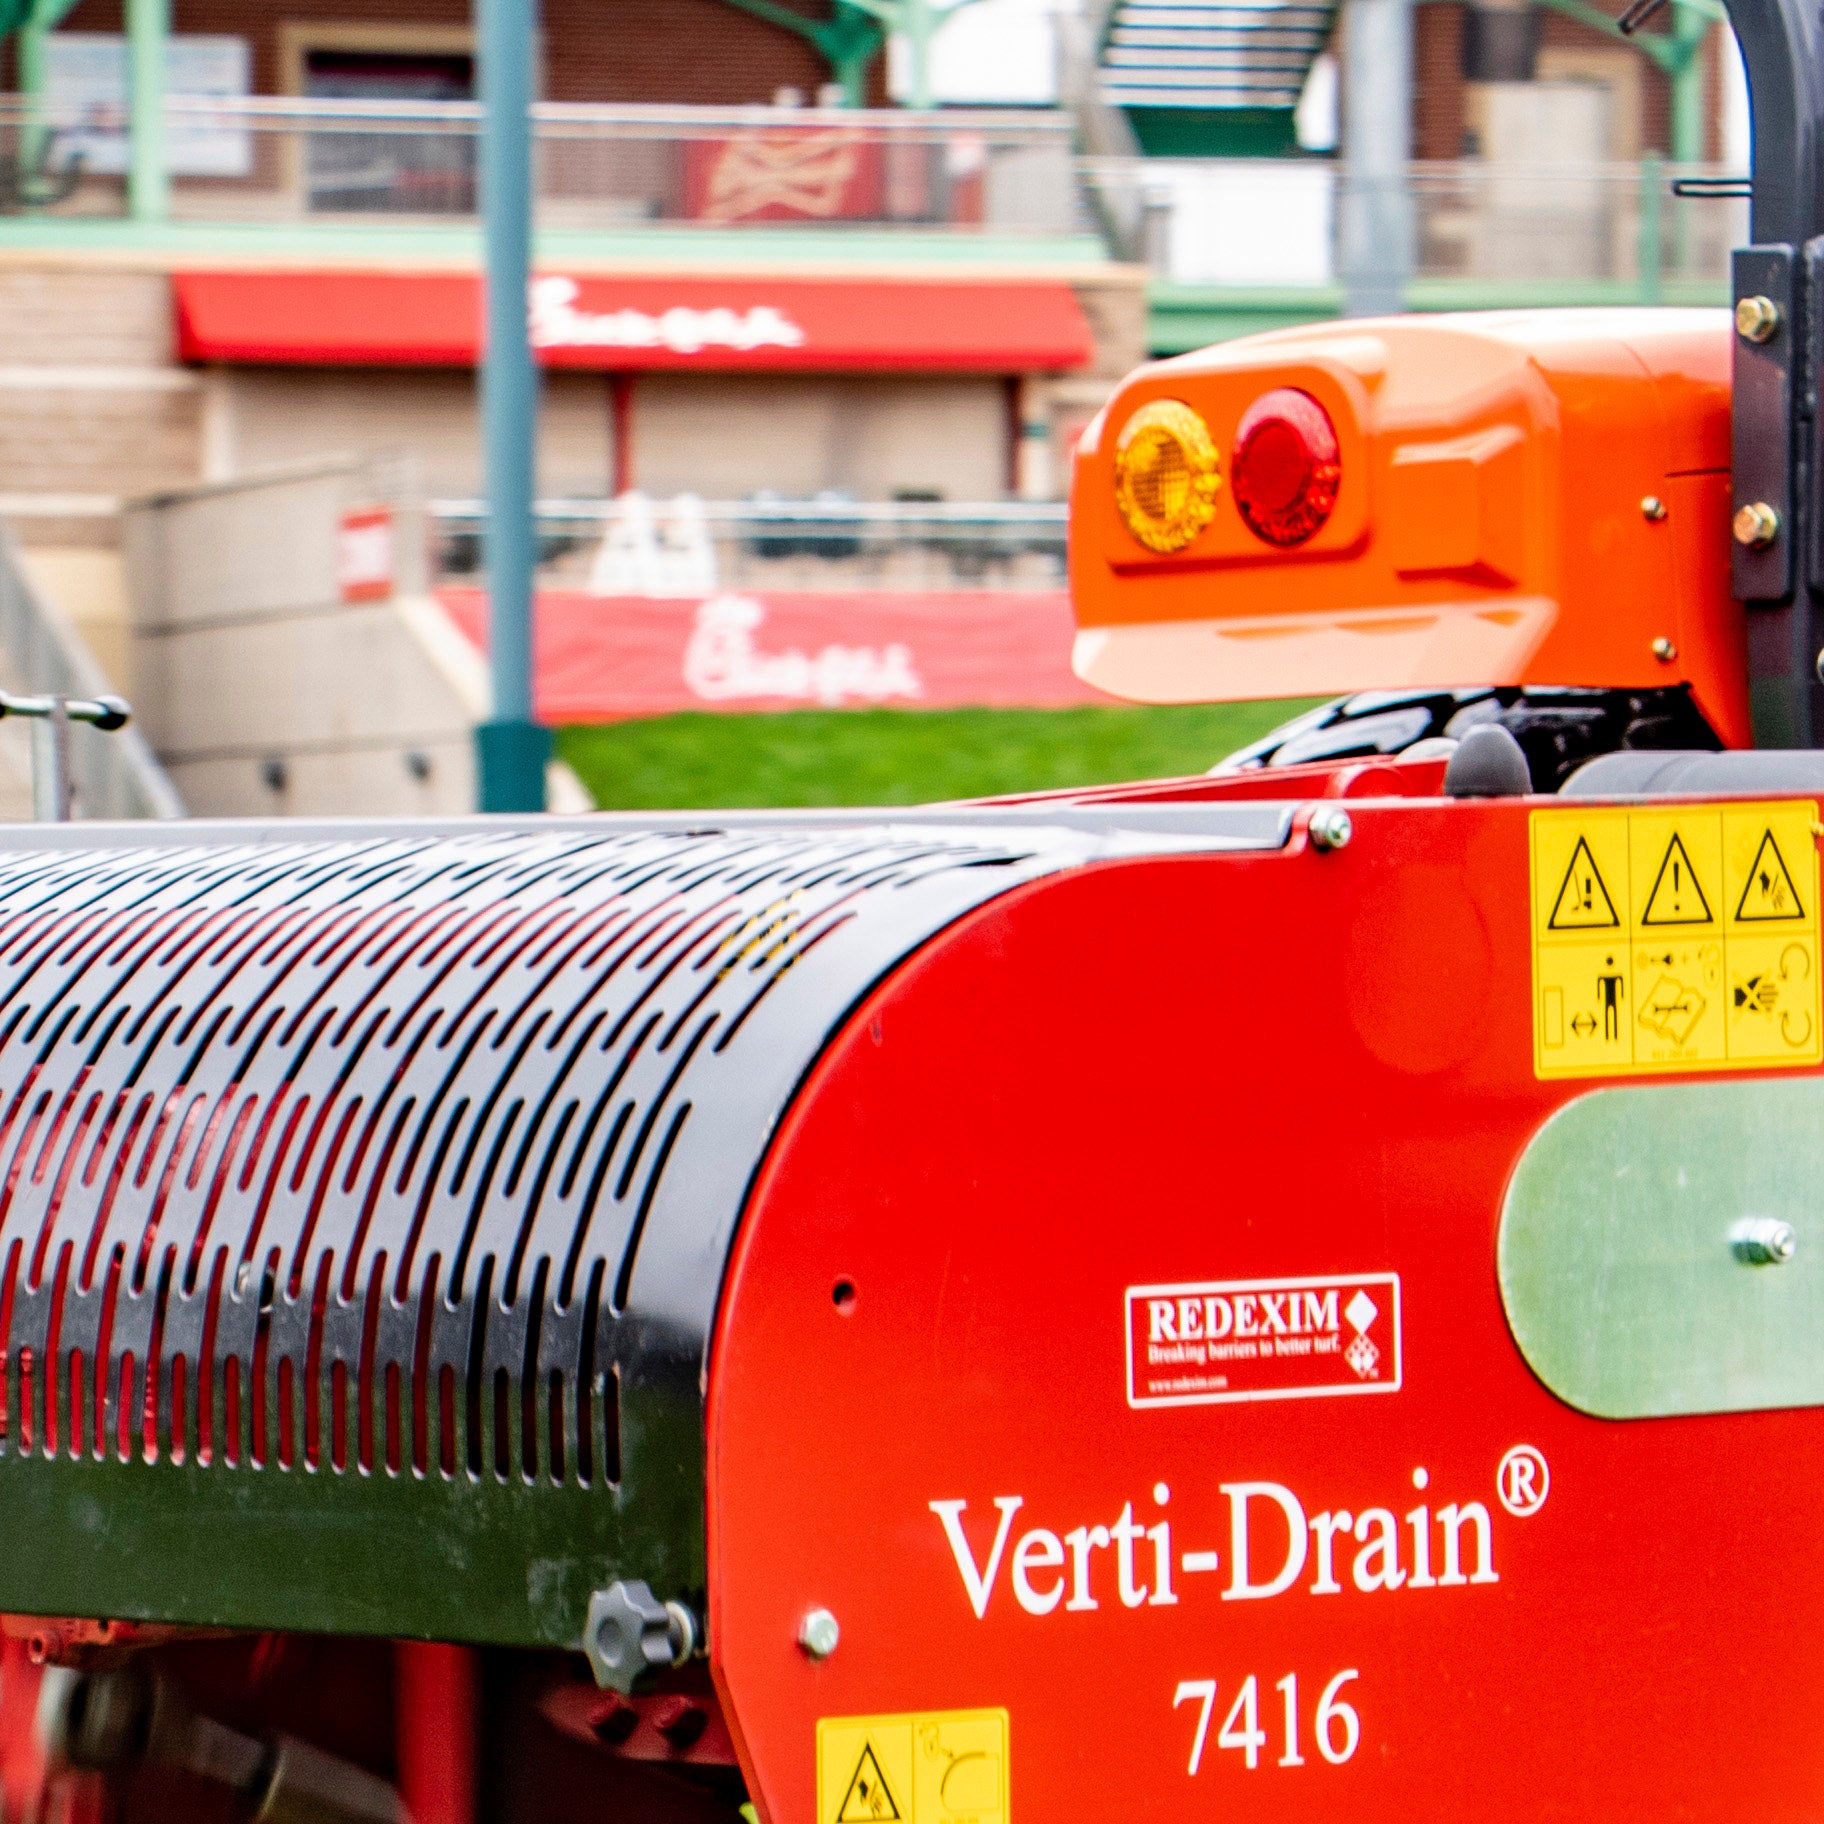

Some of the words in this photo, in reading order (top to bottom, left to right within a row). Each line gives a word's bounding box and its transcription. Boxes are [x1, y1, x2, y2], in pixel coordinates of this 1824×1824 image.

[1147, 1290, 1341, 1342] REDEXIM
[1147, 1341, 1207, 1365] Breaking
[1259, 1339, 1273, 1358] to
[1274, 1336, 1312, 1357] better
[1172, 1669, 1361, 1776] 7416
